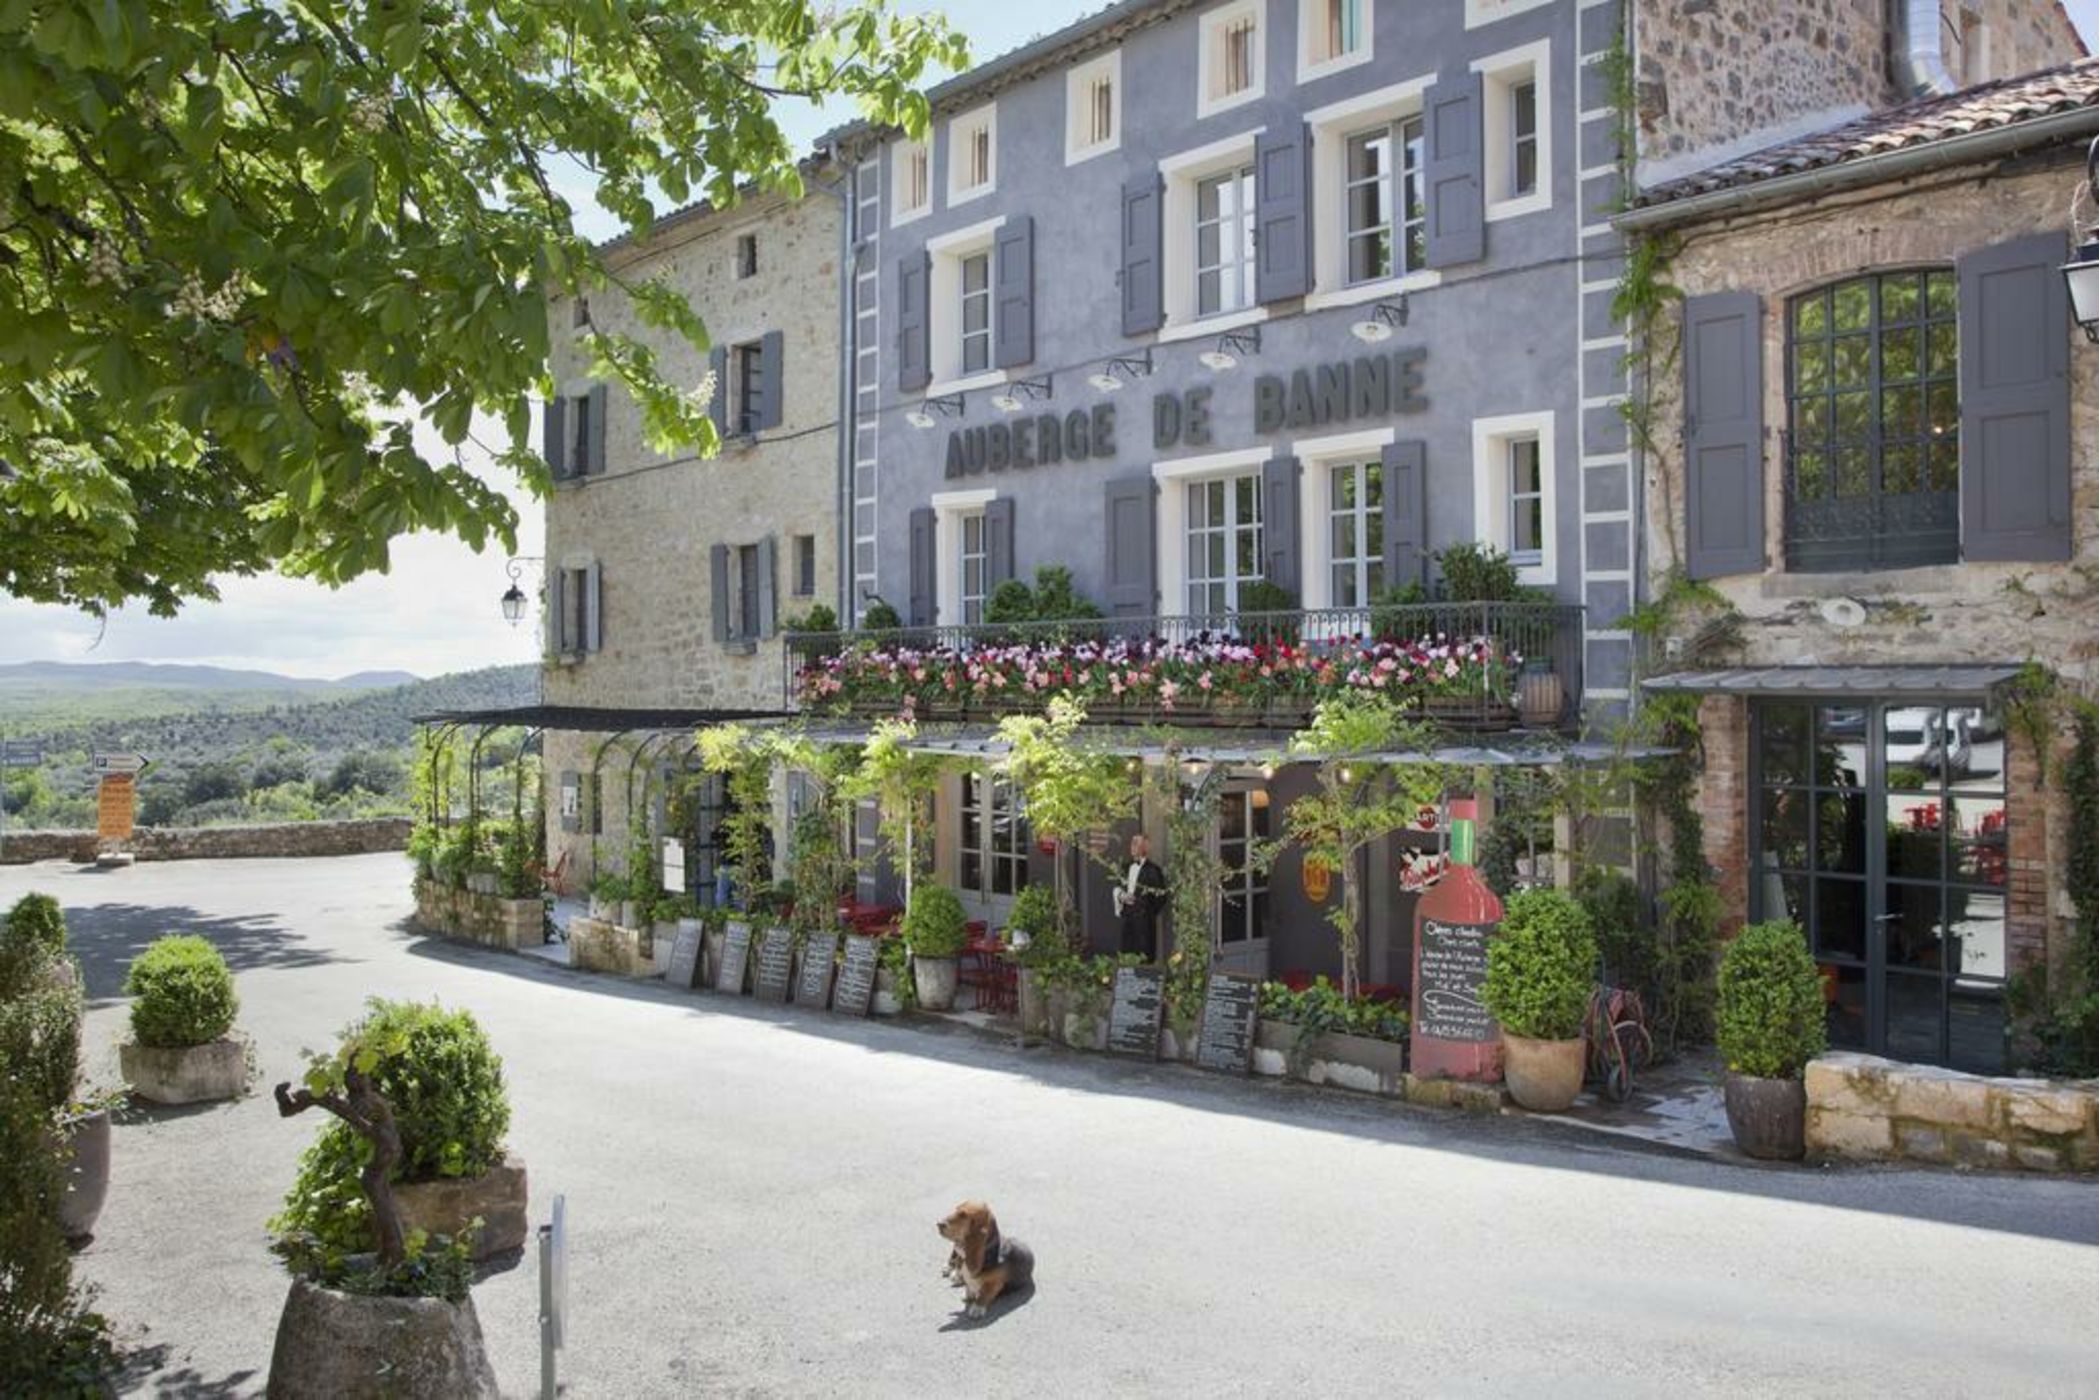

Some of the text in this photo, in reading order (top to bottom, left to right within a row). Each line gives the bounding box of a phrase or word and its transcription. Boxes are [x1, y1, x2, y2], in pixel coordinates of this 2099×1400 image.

[944, 347, 1429, 480] AUBERGE DE BANNE
